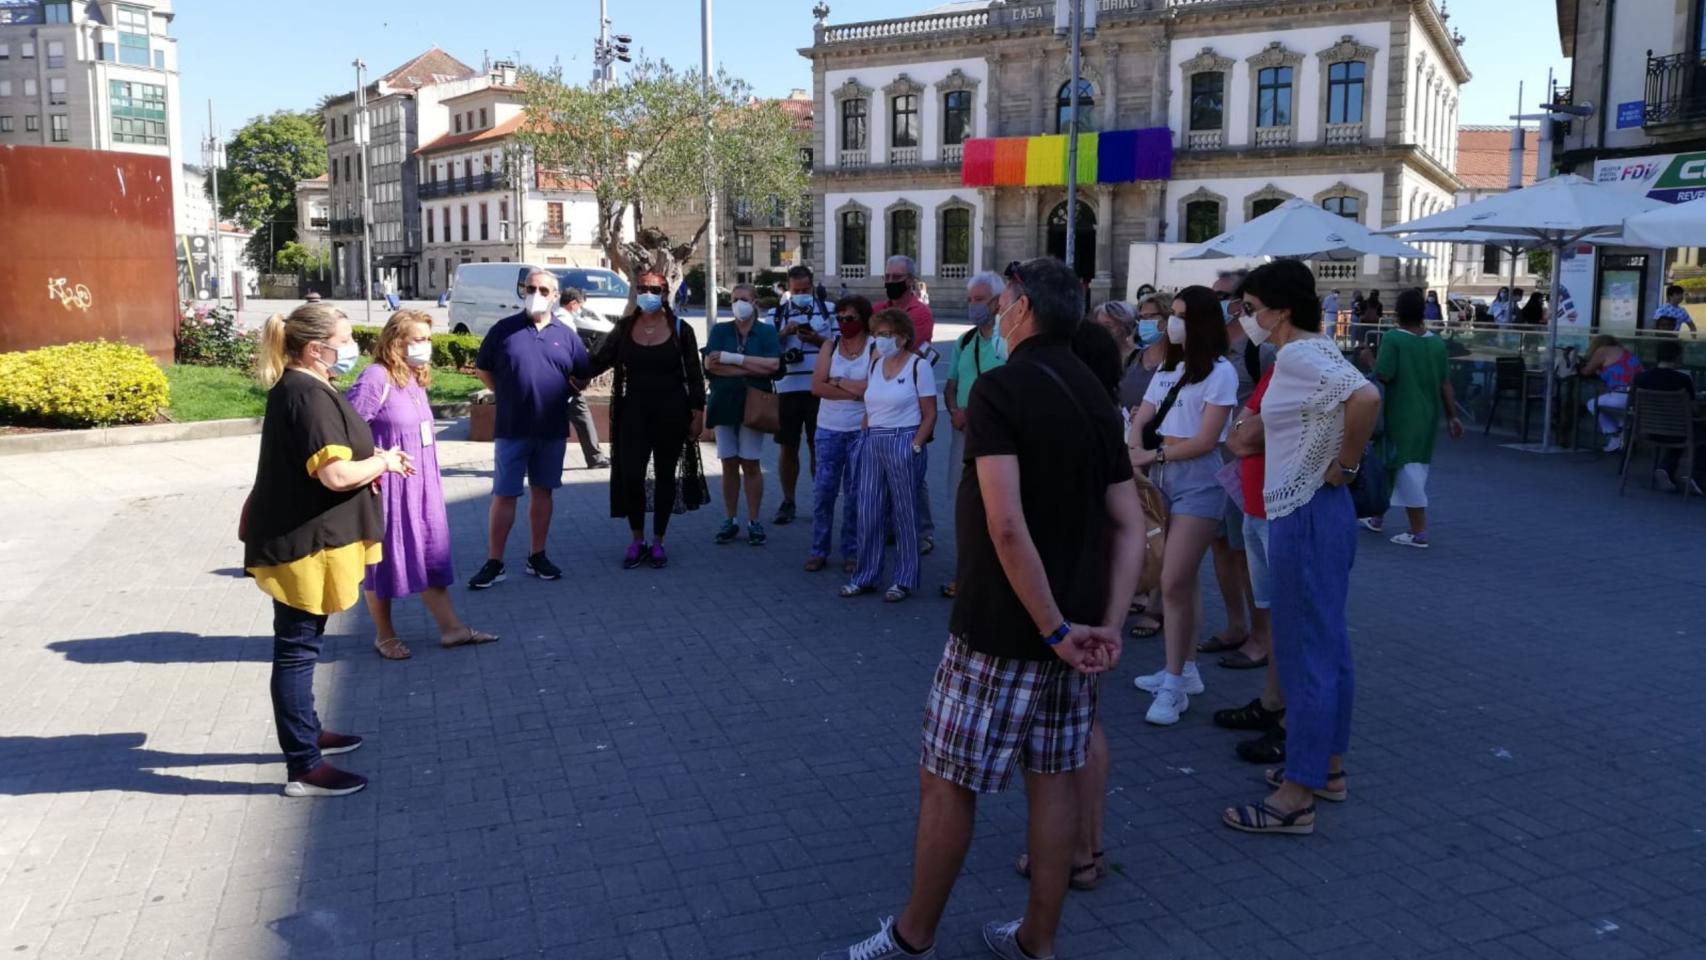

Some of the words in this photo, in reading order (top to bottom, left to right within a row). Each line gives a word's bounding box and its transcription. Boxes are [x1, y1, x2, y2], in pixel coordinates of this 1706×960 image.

[1012, 7, 1043, 20] CASA
[1679, 159, 1706, 180] C
[1677, 190, 1706, 201] REVE
